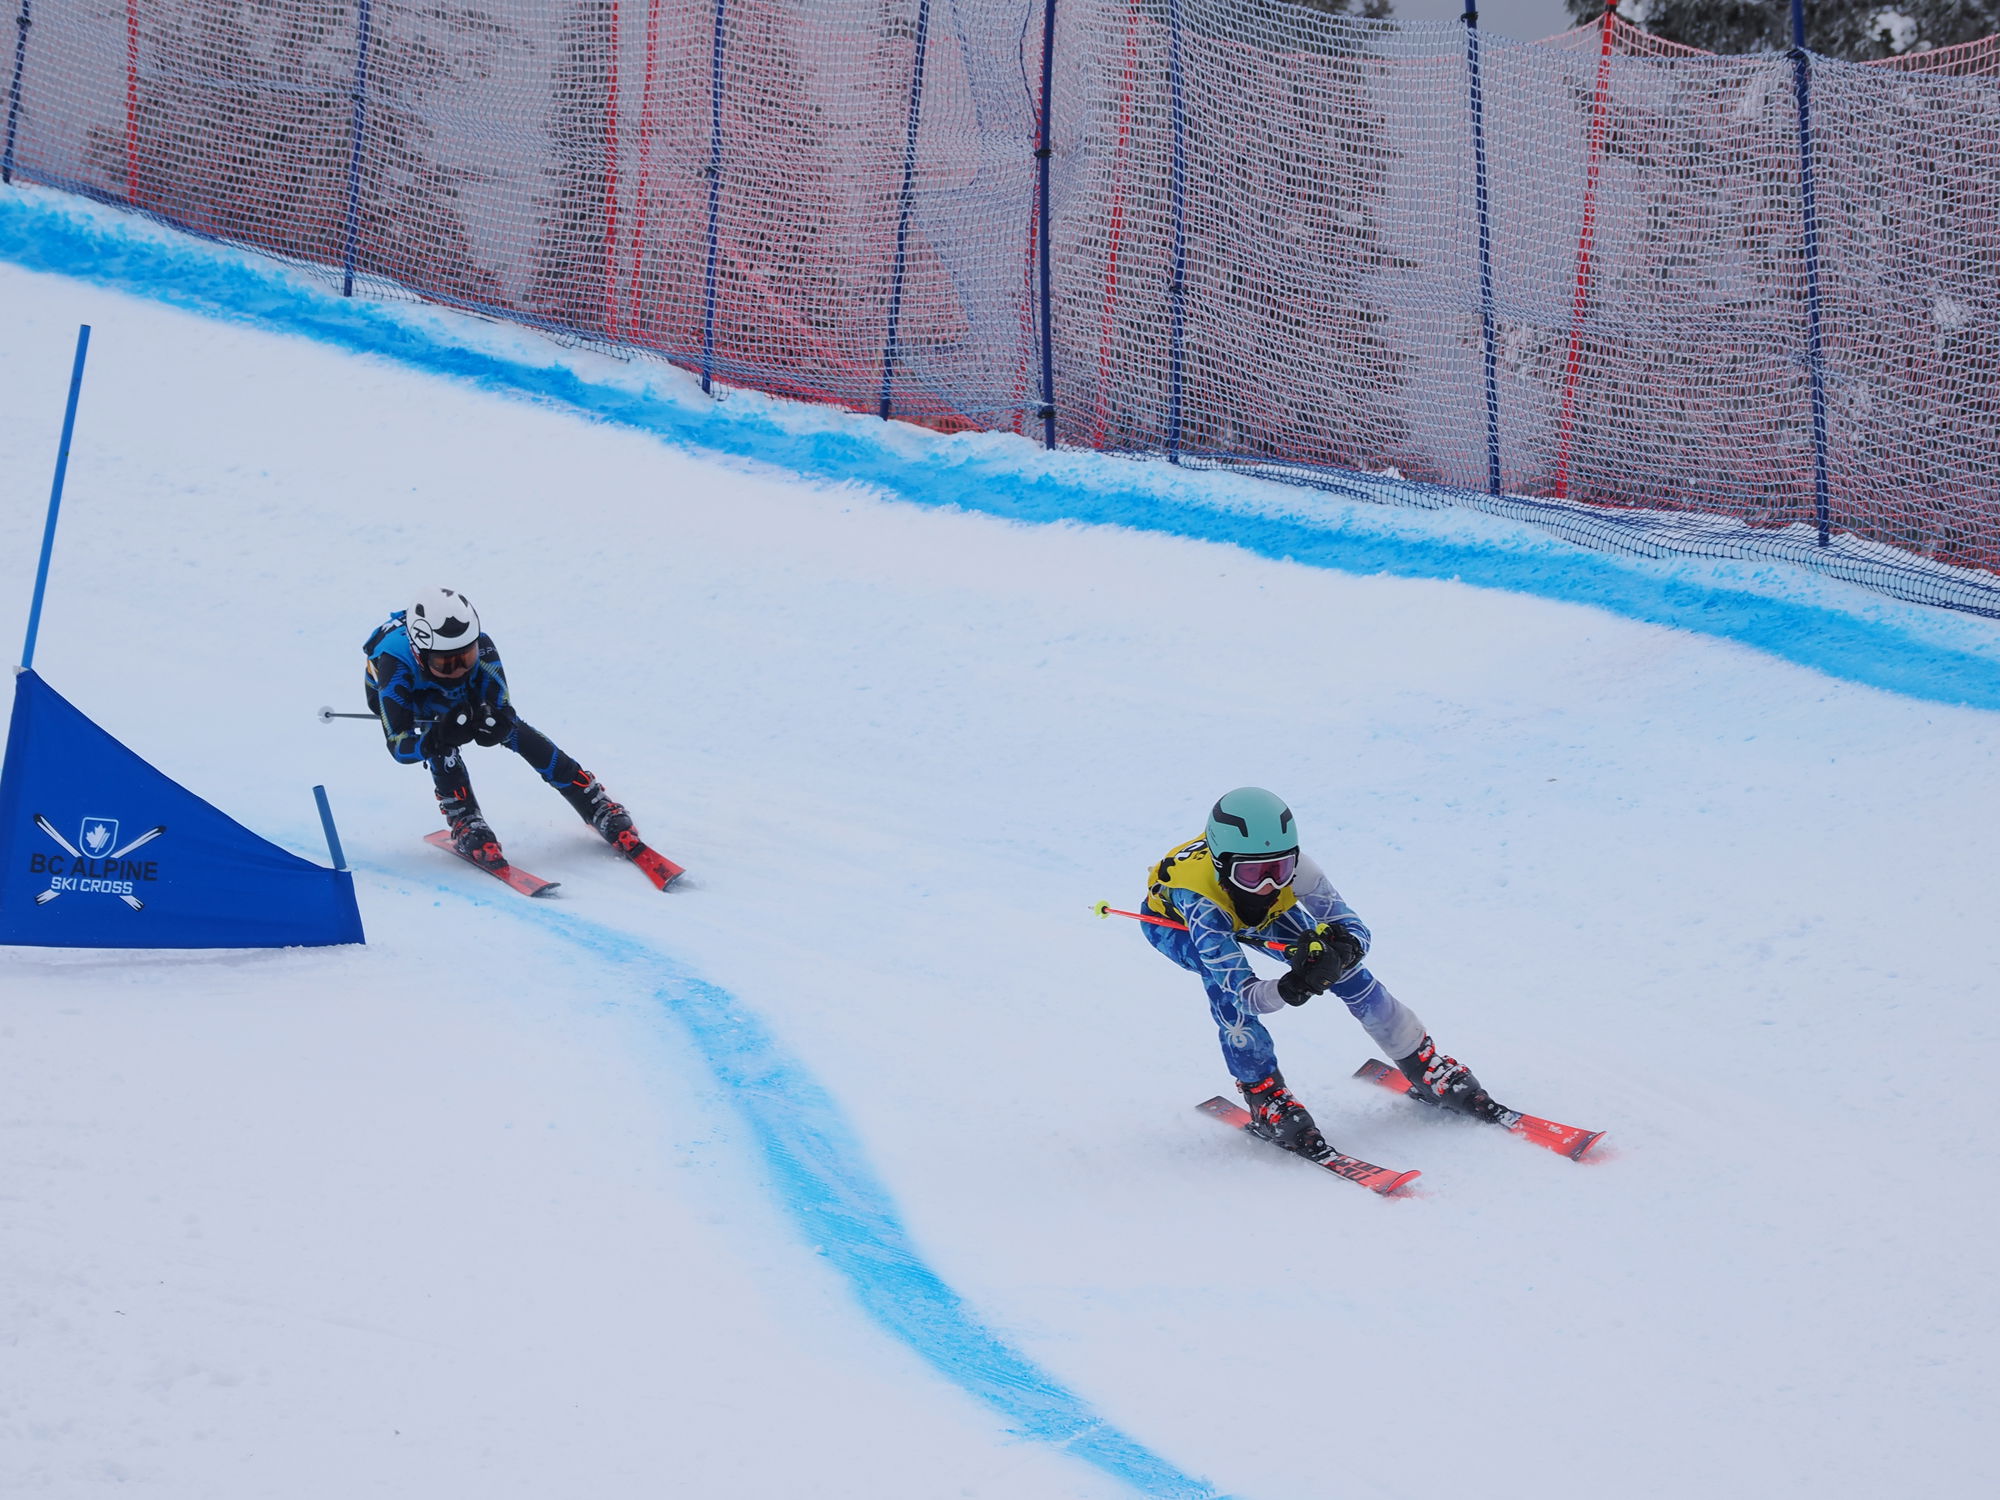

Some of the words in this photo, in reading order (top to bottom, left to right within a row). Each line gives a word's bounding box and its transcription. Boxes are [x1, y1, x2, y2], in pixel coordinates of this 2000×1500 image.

[30, 853, 65, 876] BC
[71, 857, 158, 881] ALPINE
[51, 877, 77, 891] SKI
[80, 879, 133, 894] CROSS
